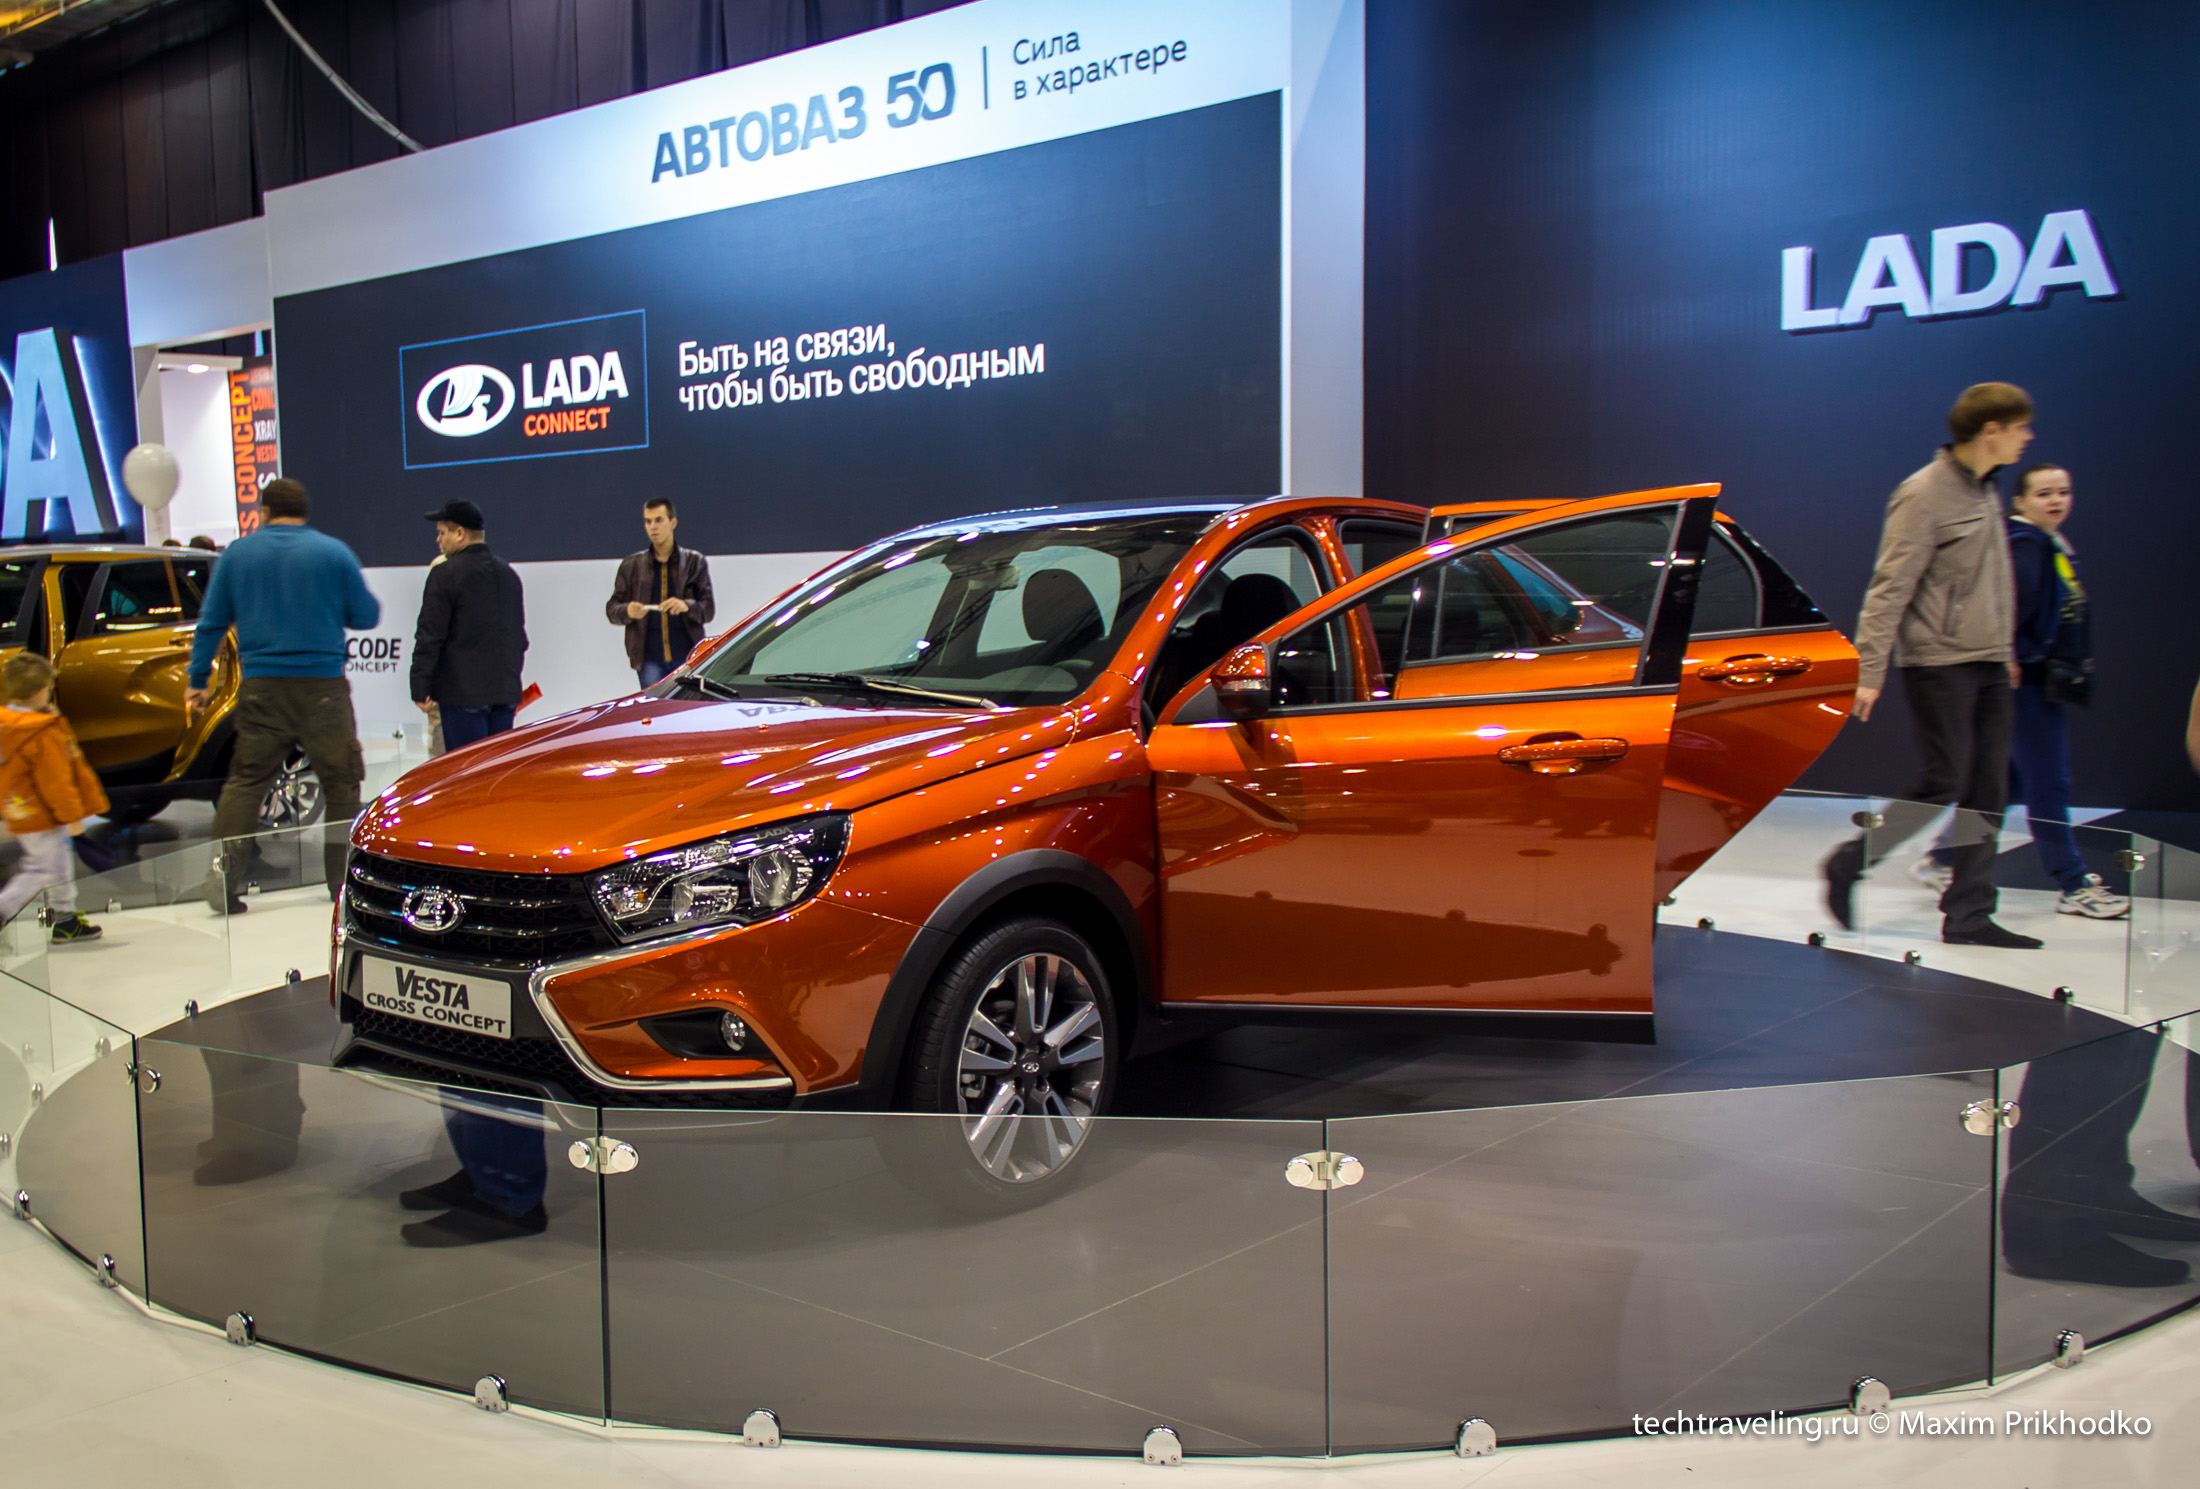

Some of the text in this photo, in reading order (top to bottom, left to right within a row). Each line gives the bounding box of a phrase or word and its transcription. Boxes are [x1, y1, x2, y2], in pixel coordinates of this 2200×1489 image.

[1013, 31, 1081, 65] Сила
[1014, 39, 1188, 100] в характере
[651, 62, 956, 183] АВТОВАЗ 50
[1780, 208, 2120, 331] LADA
[679, 323, 896, 377] Быть на связи,
[679, 343, 1045, 412] чтобы быть свободным
[522, 350, 629, 410] LADA
[0, 326, 104, 540] A
[230, 371, 259, 504] CONCEPT
[254, 419, 278, 442] XRAY
[523, 406, 611, 437] CONNECT
[346, 637, 402, 660] CODE
[366, 992, 506, 1033] CROSS CONCEPT
[395, 966, 469, 1010] VESTA
